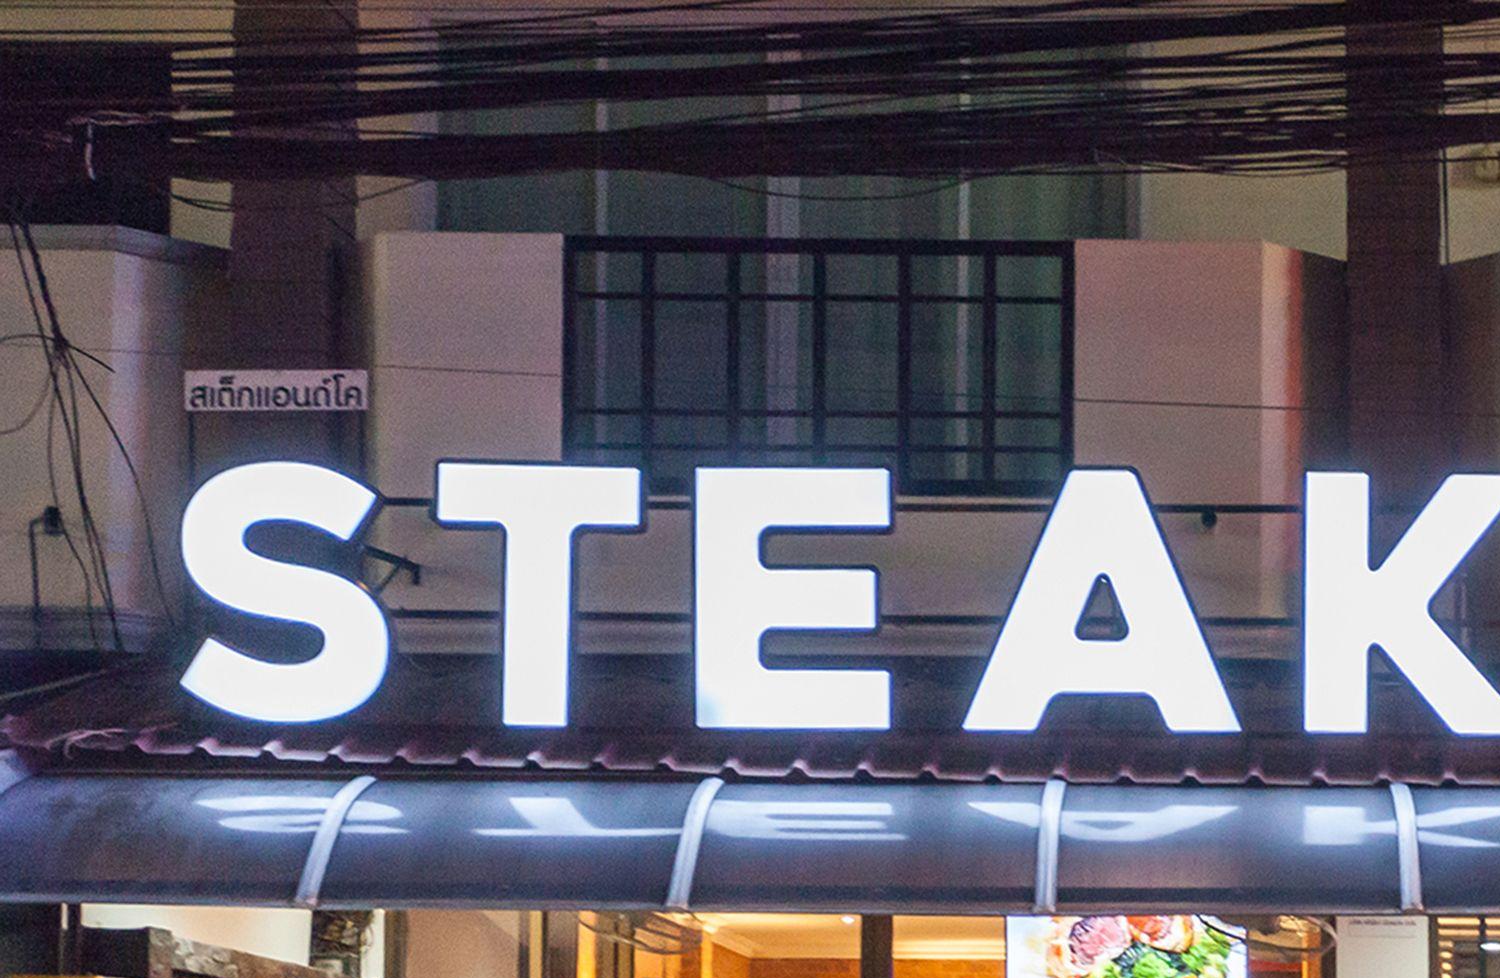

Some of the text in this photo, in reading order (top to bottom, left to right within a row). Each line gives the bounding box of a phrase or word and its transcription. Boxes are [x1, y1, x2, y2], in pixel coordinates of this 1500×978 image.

[190, 374, 363, 408] สเต็กแอนด์โค
